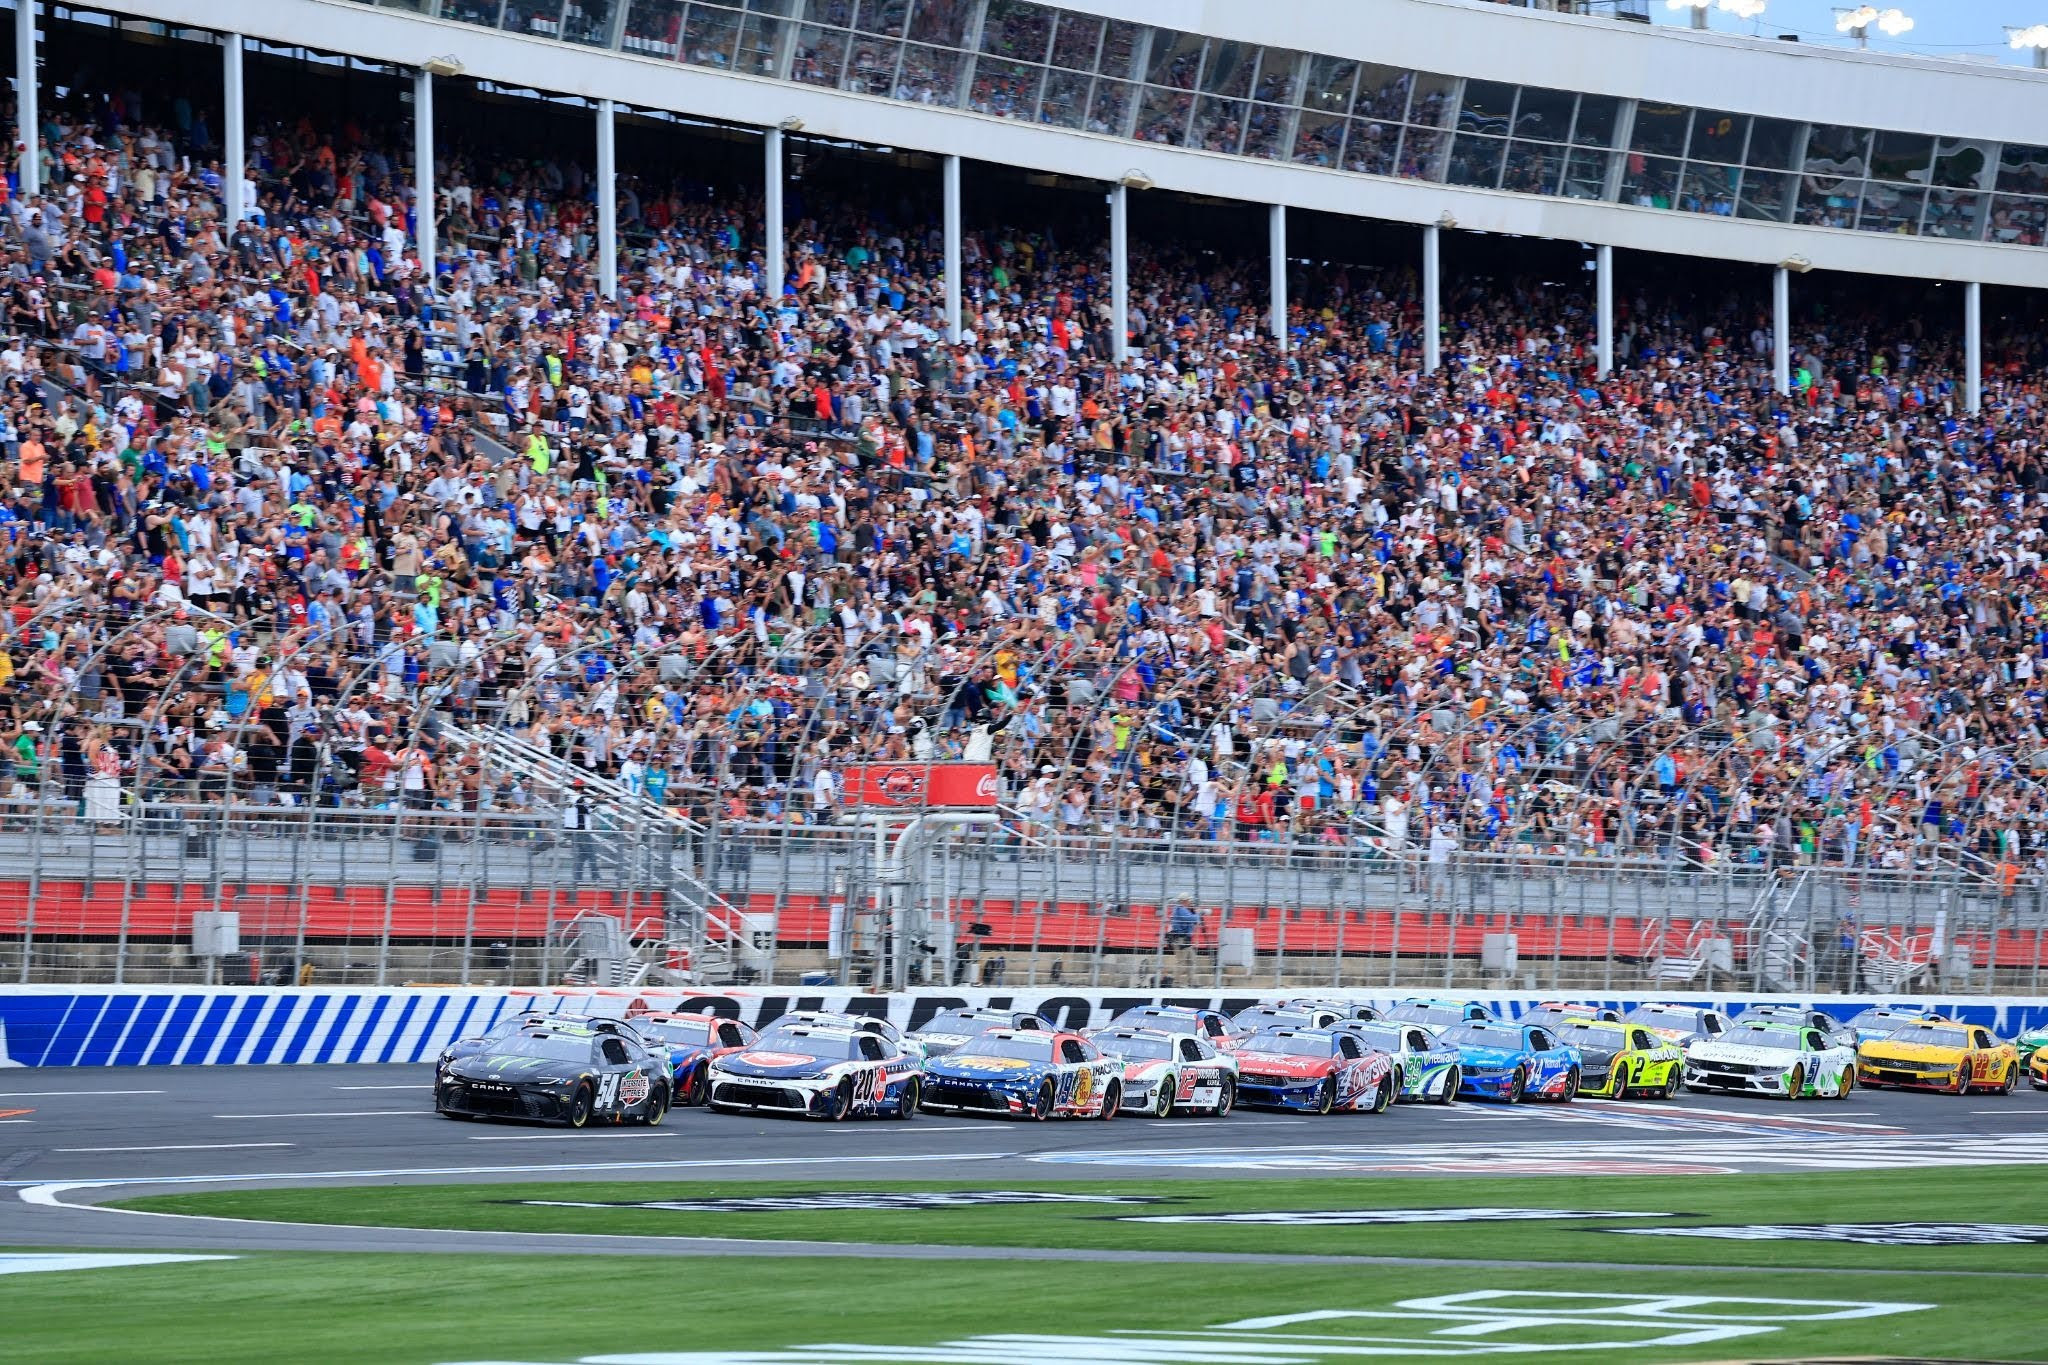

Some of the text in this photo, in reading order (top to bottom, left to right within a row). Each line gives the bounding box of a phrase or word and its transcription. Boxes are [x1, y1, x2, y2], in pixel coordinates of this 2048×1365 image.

[1404, 1056, 1424, 1088] 99
[1526, 1057, 1544, 1086] 34
[1630, 1057, 1646, 1083] 2
[1973, 1053, 1989, 1078] 22
[471, 1083, 513, 1092] CAMRY
[594, 1073, 620, 1110] 54
[620, 1088, 646, 1098] BATTERIES
[621, 1079, 647, 1088] INTERSTATE
[737, 1078, 775, 1087] CAMRY
[855, 1069, 874, 1100] 20
[944, 1080, 983, 1088] CAMRY
[1175, 1067, 1198, 1100] 12
